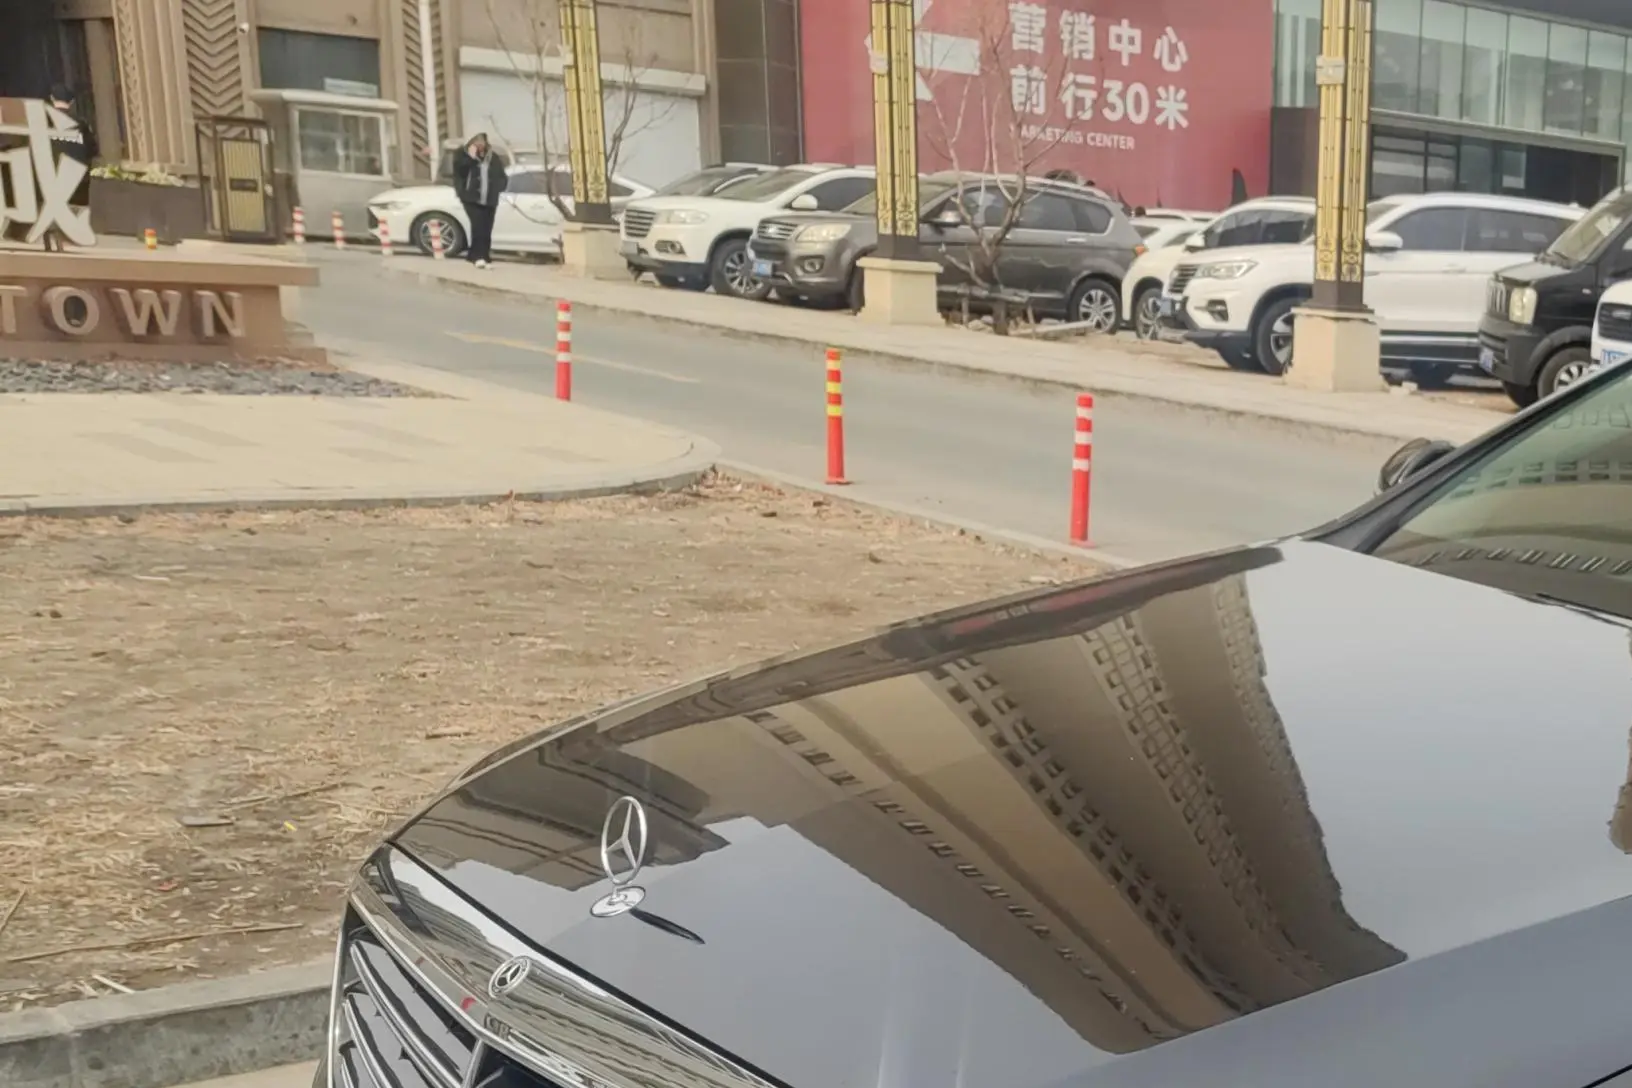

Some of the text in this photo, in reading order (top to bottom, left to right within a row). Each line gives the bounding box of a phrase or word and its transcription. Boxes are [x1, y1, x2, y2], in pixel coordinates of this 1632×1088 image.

[1008, 3, 1188, 72] 营销中心
[1009, 64, 1189, 130] 前行30米
[1087, 131, 1135, 150] CENTER
[0, 285, 246, 338] TOWN
